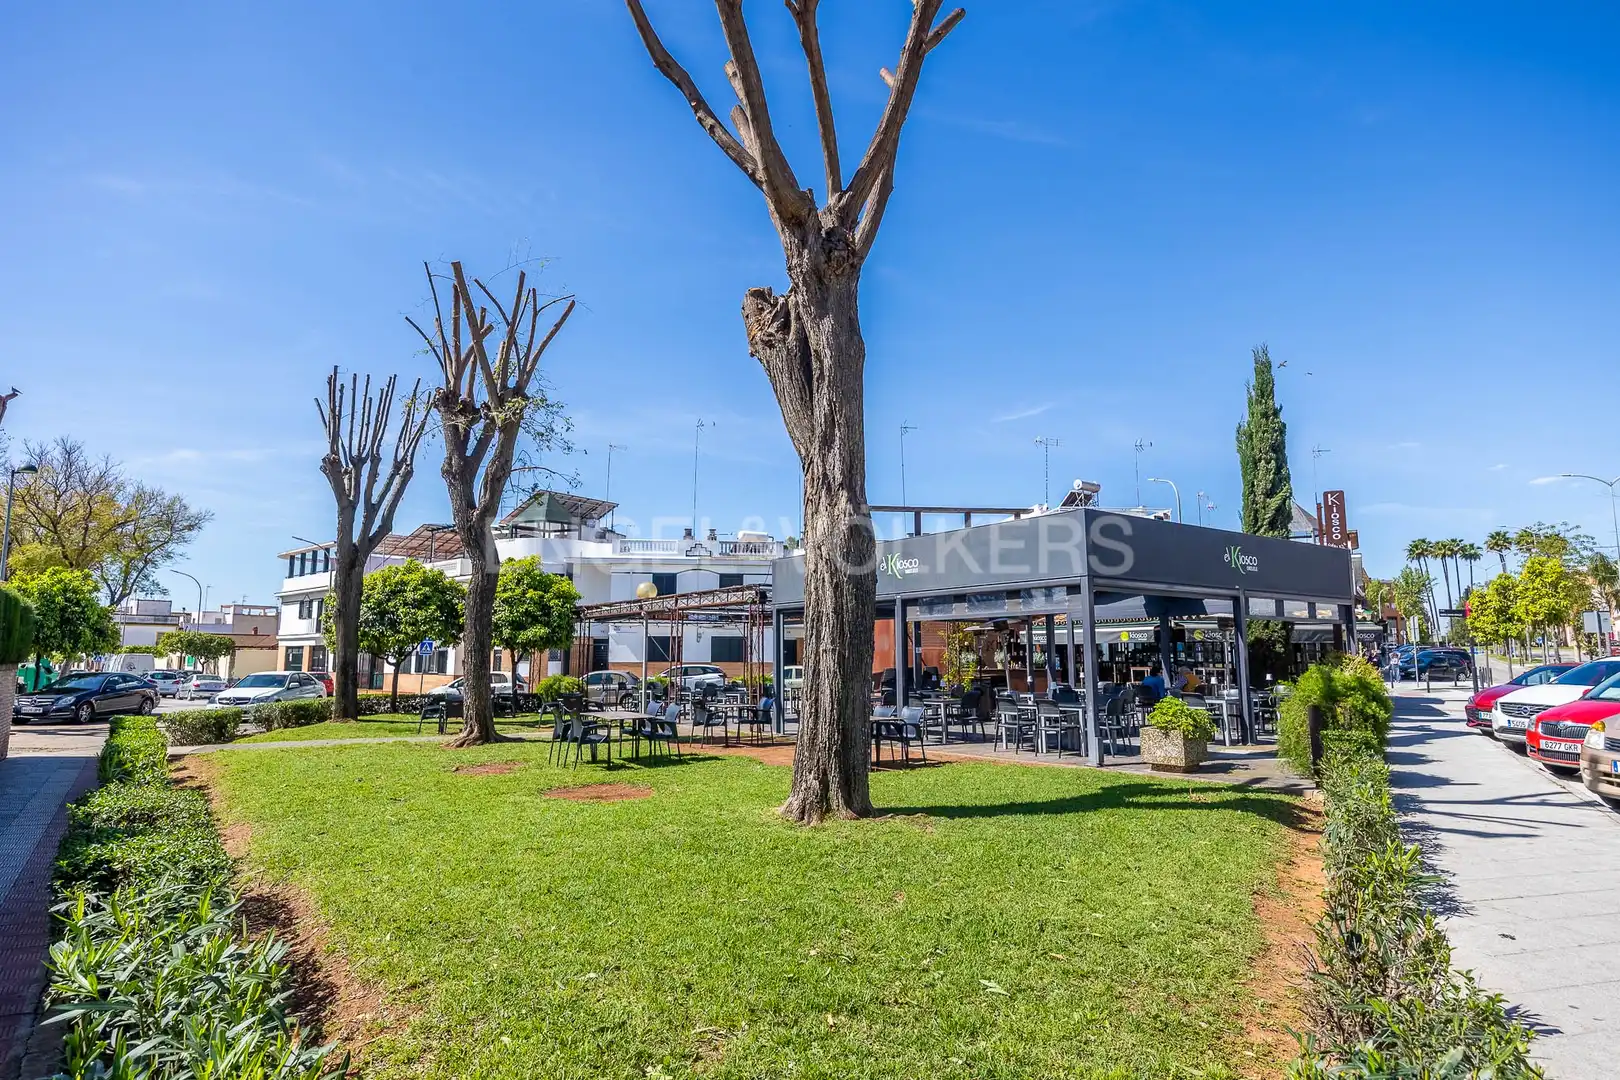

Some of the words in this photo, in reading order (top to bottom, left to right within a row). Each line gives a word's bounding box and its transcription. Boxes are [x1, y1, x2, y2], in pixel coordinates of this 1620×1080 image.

[1327, 492, 1341, 540] Kiosco
[1544, 740, 1562, 750] 6277
[1563, 742, 1579, 752] GKR
